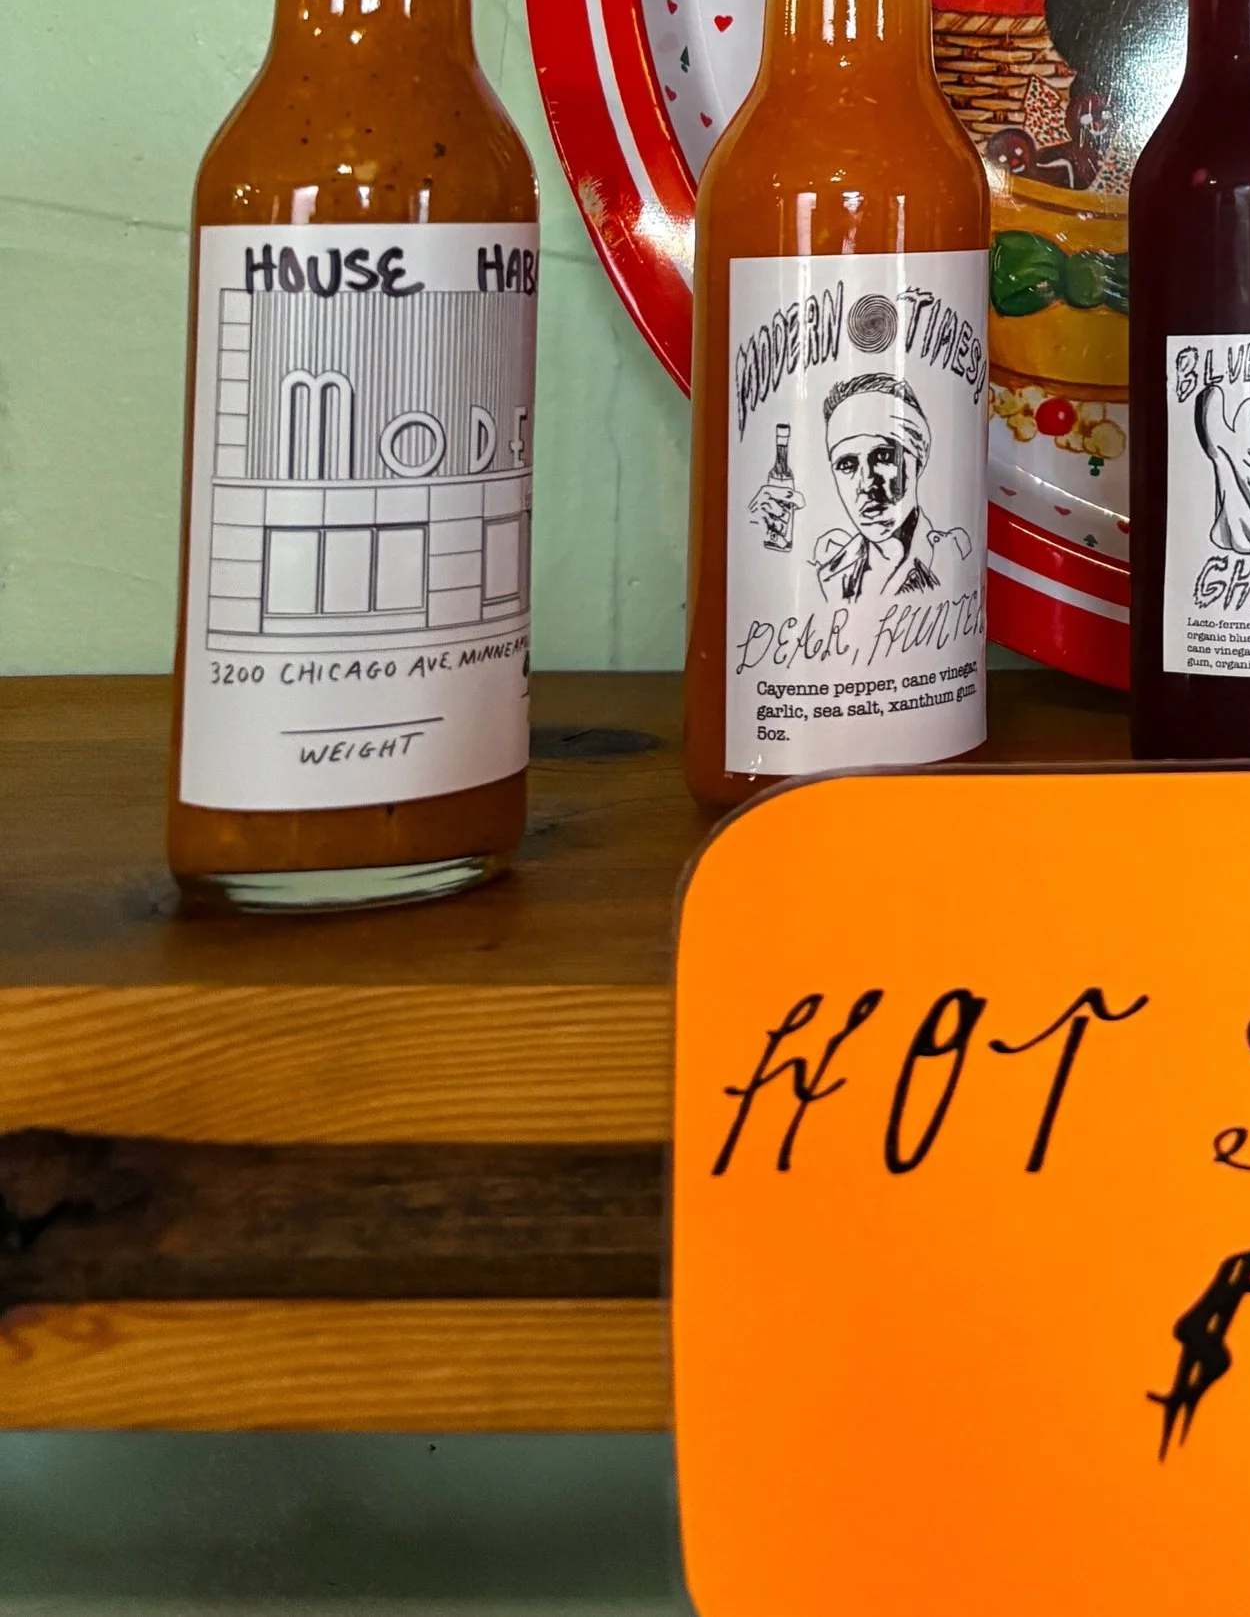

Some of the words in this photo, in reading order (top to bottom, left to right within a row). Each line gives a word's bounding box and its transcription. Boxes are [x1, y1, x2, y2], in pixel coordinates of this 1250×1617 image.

[246, 243, 426, 298] HOUSE
[477, 243, 540, 296] HAB
[736, 280, 844, 443] MODERN
[896, 286, 987, 405] TIMES!
[736, 607, 860, 675] DEAR,
[1186, 630, 1227, 642] organic
[1186, 644, 1212, 654] cane
[210, 661, 265, 685] 3200
[280, 660, 398, 685] CHICAGO
[1186, 656, 1213, 668] gum,
[756, 681, 830, 700] Cayenne
[833, 678, 898, 698] pepper,
[901, 671, 937, 689] cane
[756, 704, 809, 722] garlic,
[812, 706, 844, 718] sea
[846, 701, 885, 717] salt,
[887, 689, 955, 714] xanthum
[300, 731, 425, 764] WEIGHT
[756, 726, 791, 742] 5oz.
[709, 987, 1152, 1178] HOT
